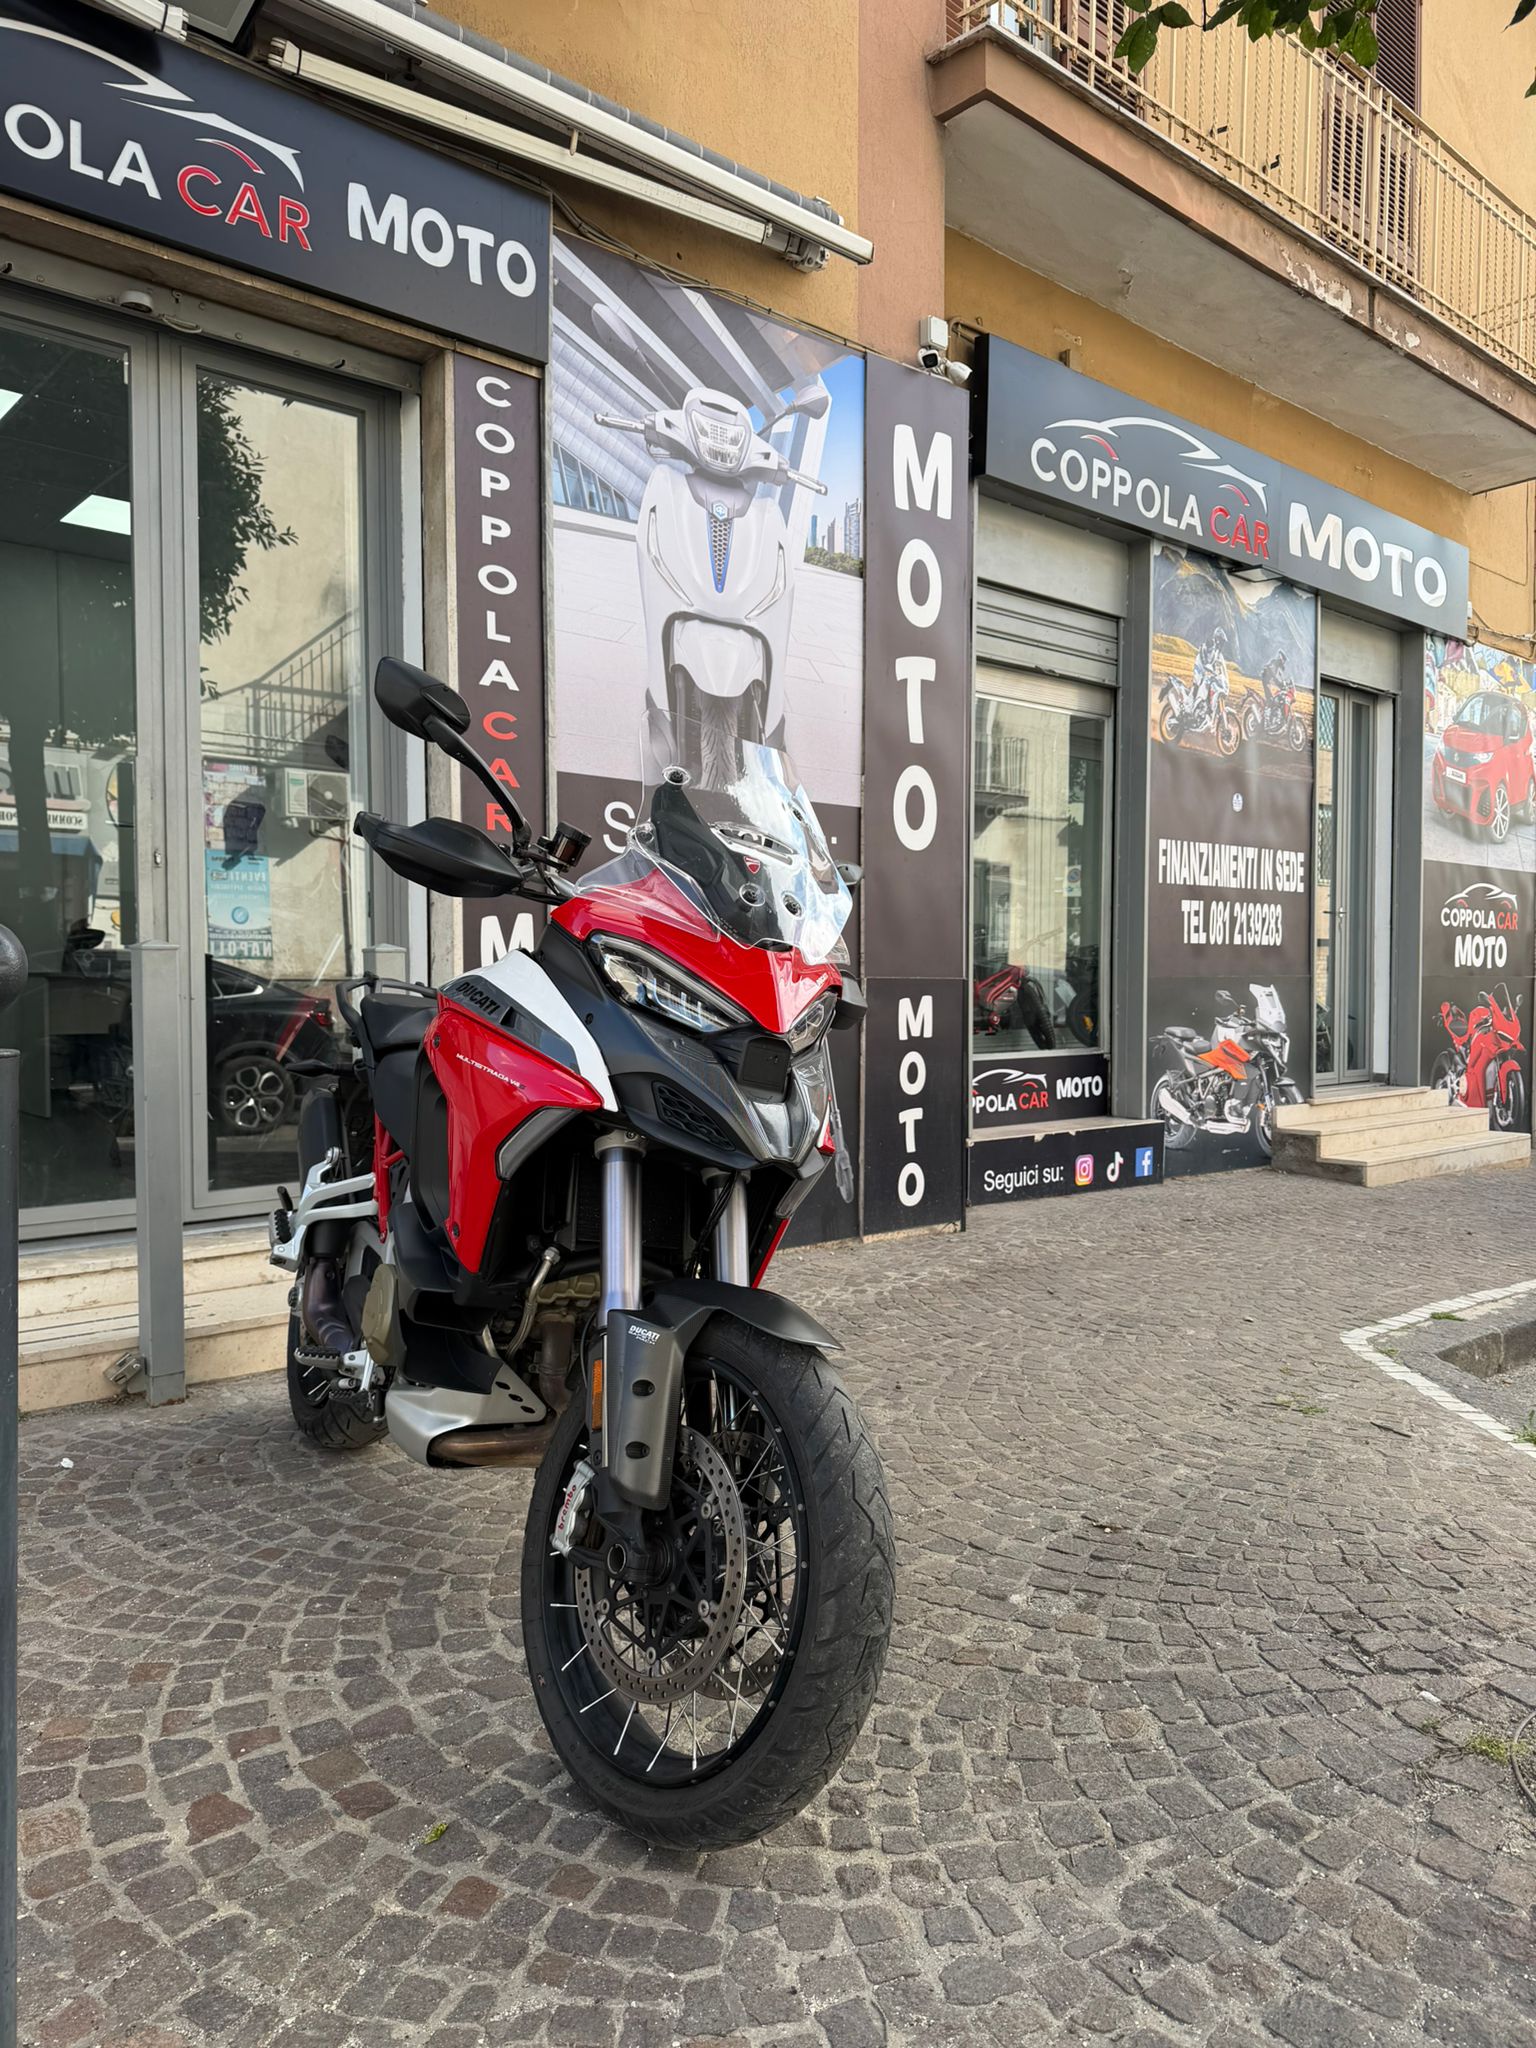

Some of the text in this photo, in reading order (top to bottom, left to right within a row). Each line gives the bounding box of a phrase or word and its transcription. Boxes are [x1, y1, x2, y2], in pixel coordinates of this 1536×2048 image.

[177, 164, 312, 251] CAR
[348, 182, 536, 298] MOTO
[1030, 438, 1447, 608] COPPOLA CAR MOTO
[893, 424, 952, 851] MOTO
[1158, 838, 1304, 892] FINANZIAMENTI IN SEDE
[1181, 900, 1282, 946] TEL 081 2139283
[1441, 907, 1518, 930] COPPOLA CAR
[1454, 934, 1507, 969] MOTO
[455, 982, 500, 1016] DUCATI
[898, 995, 933, 1207] MOTO
[1019, 1091, 1049, 1111] CAR
[1056, 1075, 1103, 1100] MOTO
[984, 1164, 1064, 1194] Seguici su:
[558, 1485, 577, 1530] brembo
